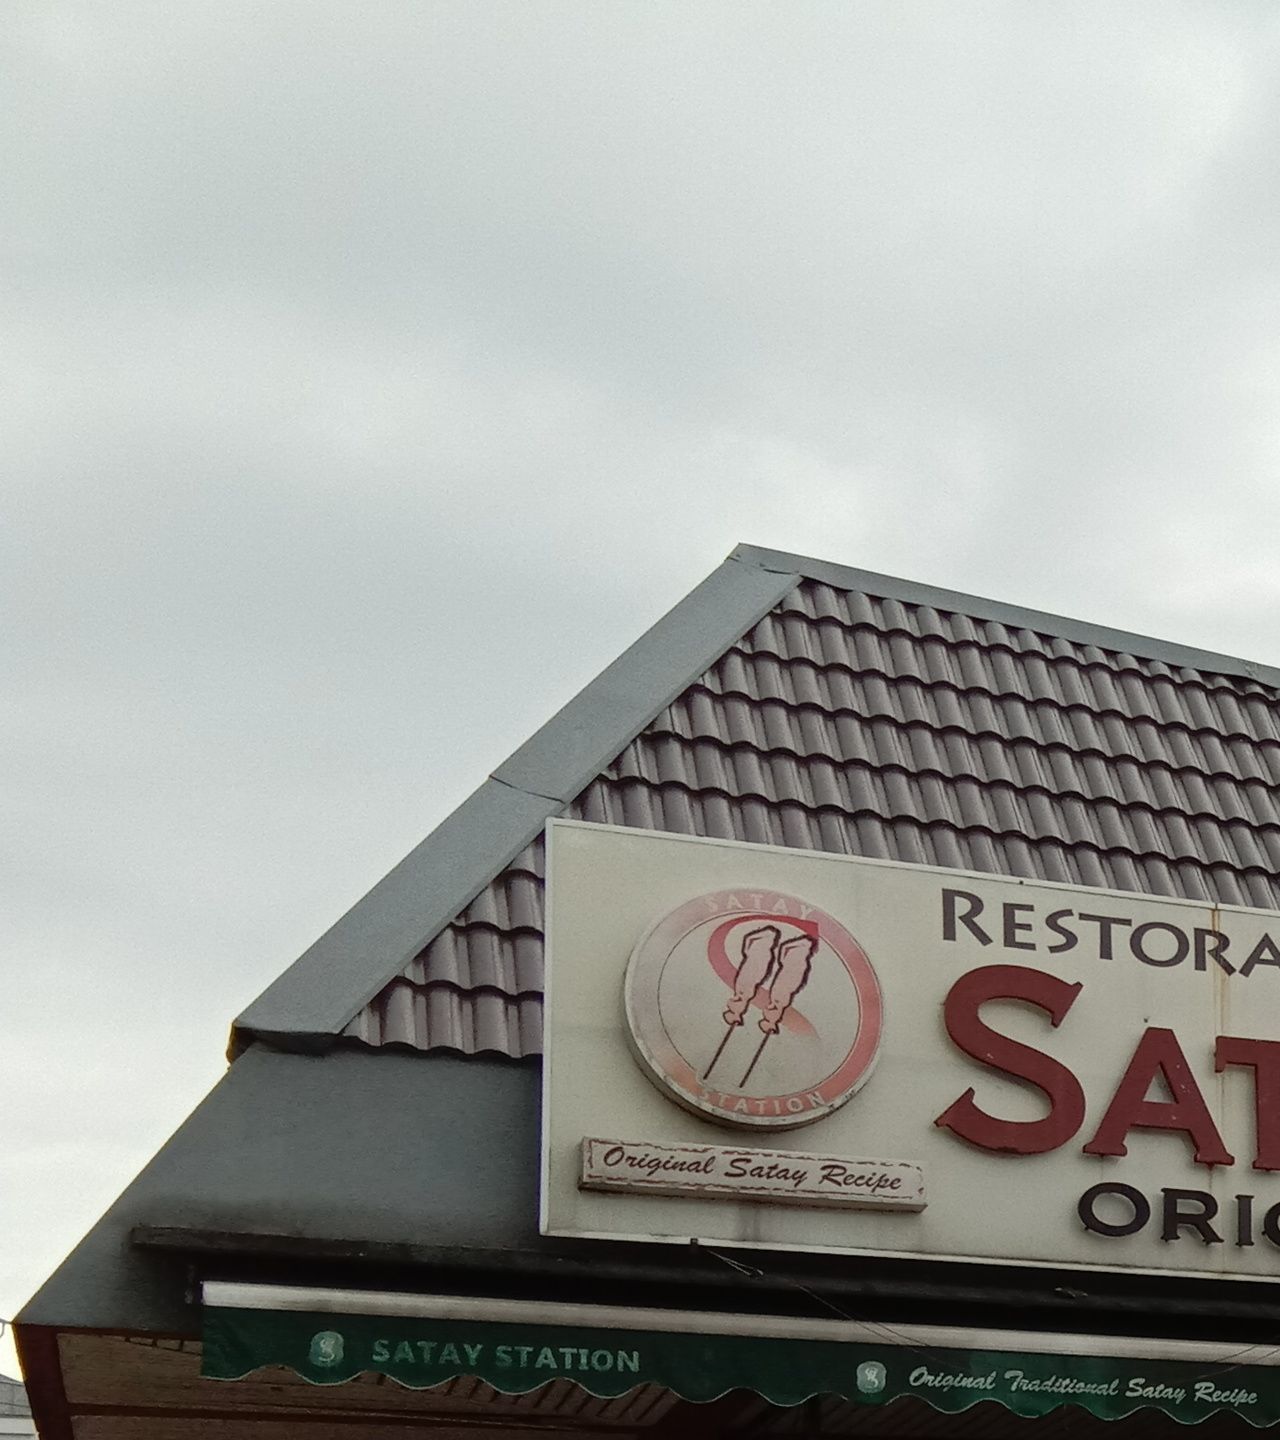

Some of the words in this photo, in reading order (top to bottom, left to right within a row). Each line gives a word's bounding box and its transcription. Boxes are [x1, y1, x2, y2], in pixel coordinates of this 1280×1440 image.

[703, 893, 816, 919] SATAY
[697, 1088, 826, 1116] STATION
[601, 1146, 716, 1181] Original
[726, 1155, 808, 1191] Satay
[819, 1162, 903, 1193] Recipe
[372, 1339, 483, 1367] SATAY
[495, 1345, 640, 1373] STATION
[908, 1366, 996, 1393] Original
[1003, 1369, 1120, 1398] Traditional
[1126, 1378, 1186, 1402] Satay
[1194, 1382, 1258, 1406] Recipe
